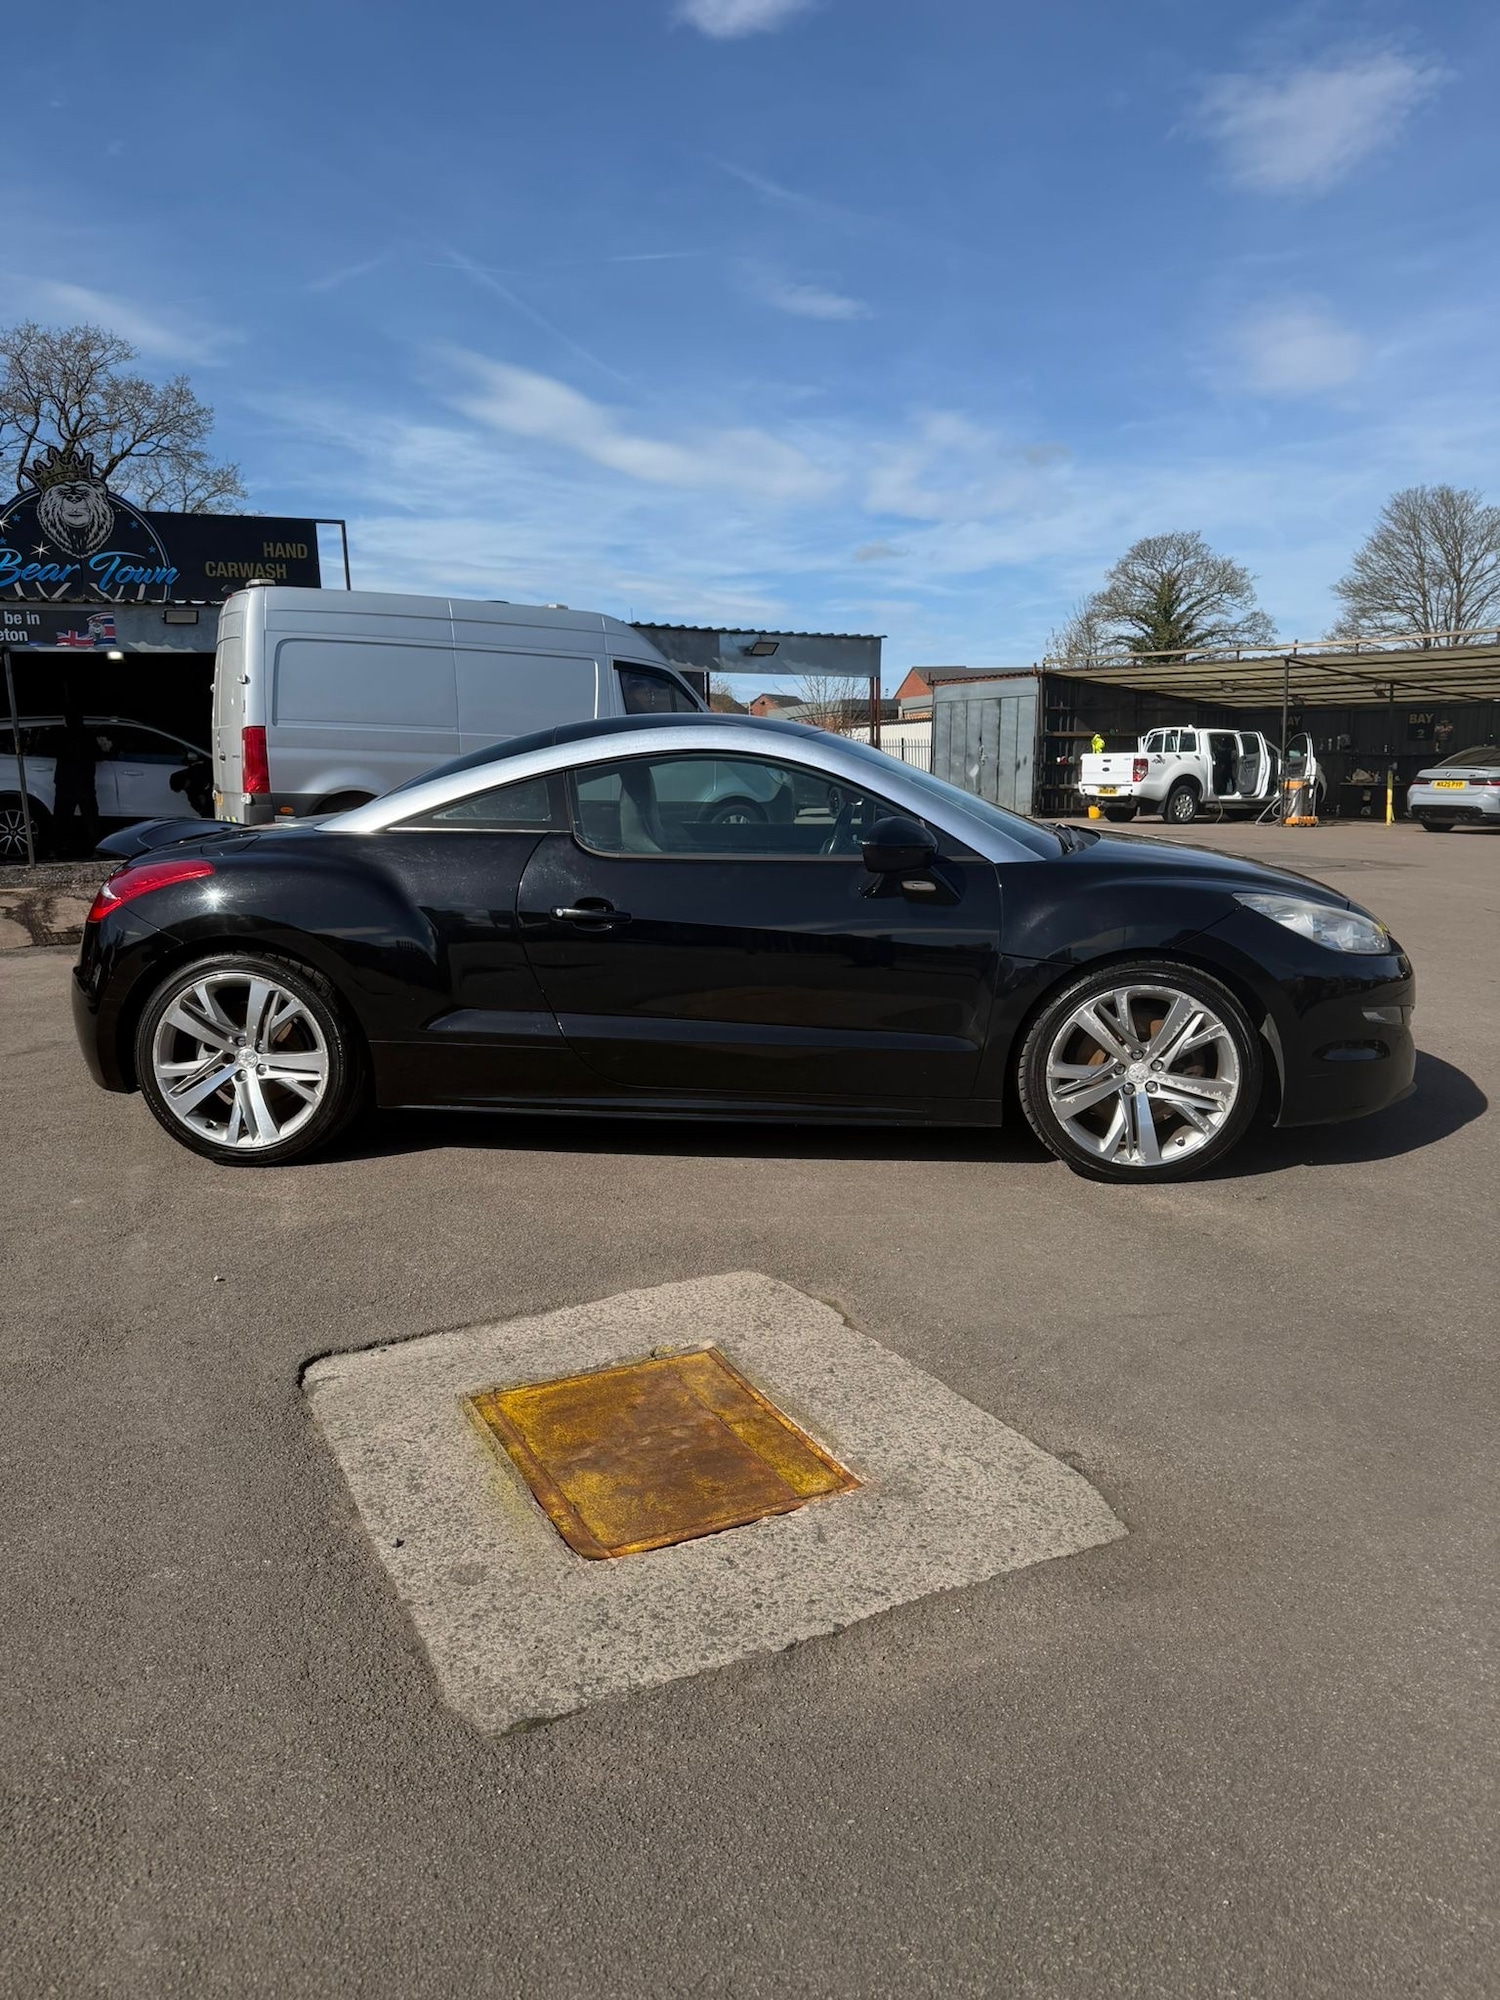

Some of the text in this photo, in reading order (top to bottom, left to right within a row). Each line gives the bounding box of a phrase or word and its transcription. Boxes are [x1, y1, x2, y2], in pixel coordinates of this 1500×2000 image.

[262, 541, 309, 560] HAND
[0, 548, 181, 592] Bear Town
[204, 560, 288, 580] CARWASH
[4, 611, 40, 625] be in
[1408, 713, 1434, 724] BAY
